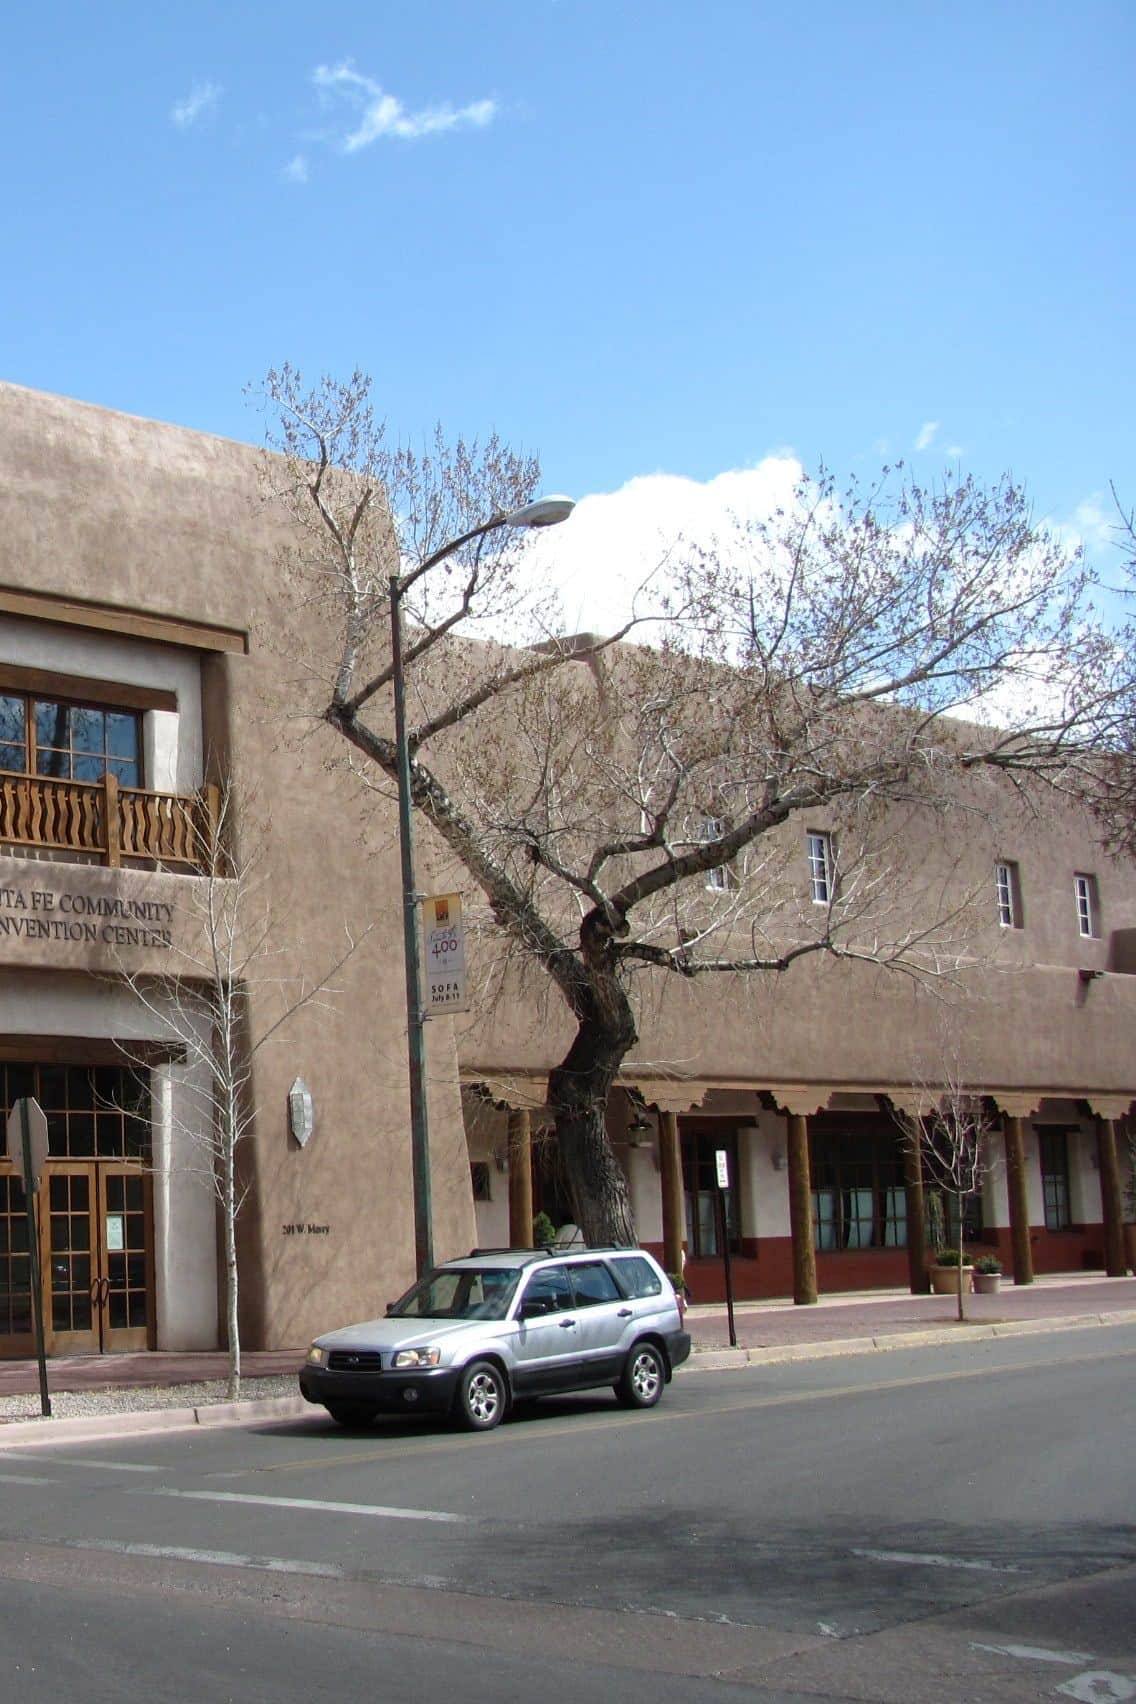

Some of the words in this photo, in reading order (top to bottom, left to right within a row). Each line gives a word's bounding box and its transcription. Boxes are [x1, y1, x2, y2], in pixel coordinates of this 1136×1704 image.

[31, 891, 54, 911] FE
[59, 894, 176, 923] COMMUNITY
[102, 924, 172, 949] CENTER
[432, 939, 457, 959] 400
[431, 983, 458, 993] SOFA
